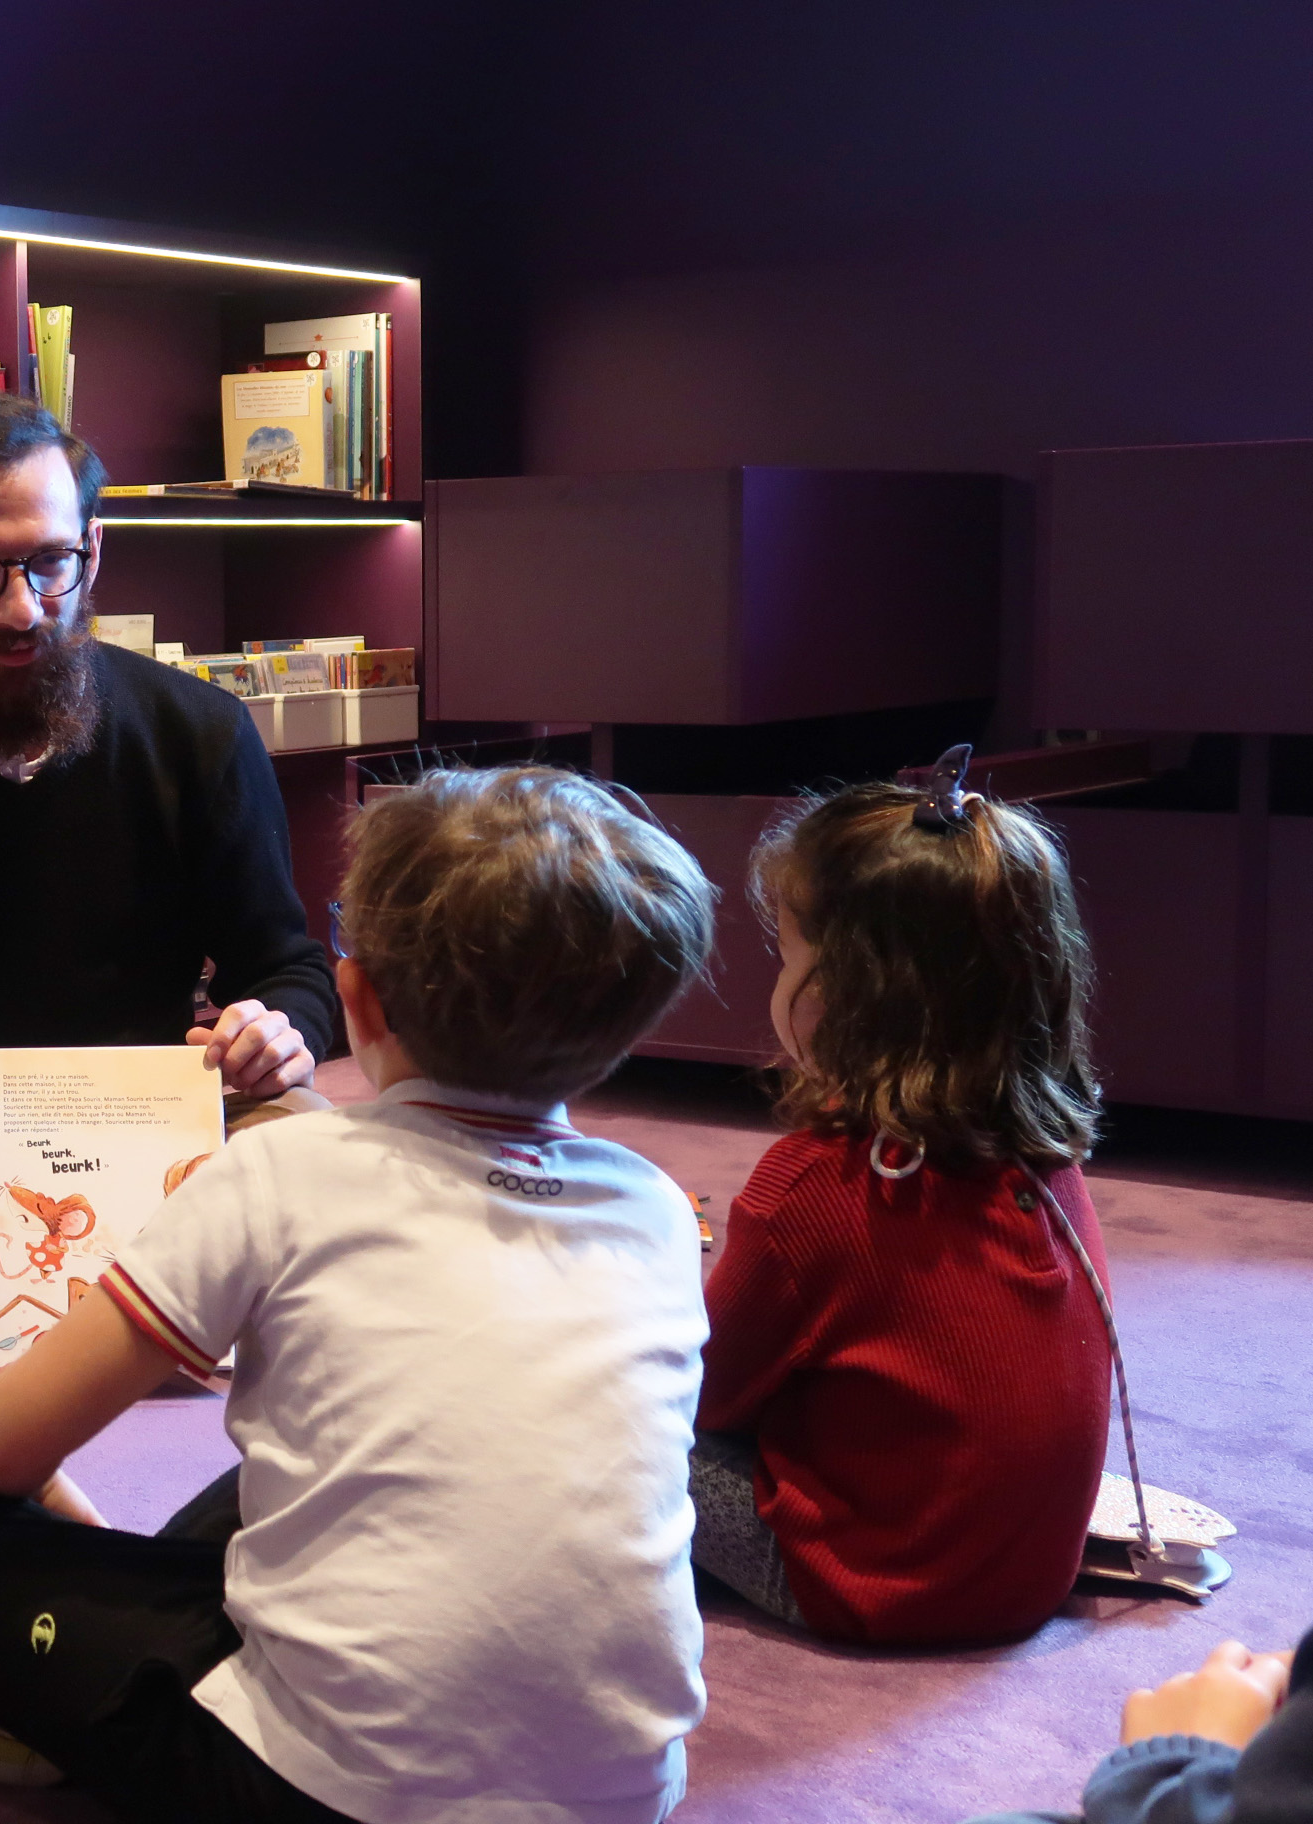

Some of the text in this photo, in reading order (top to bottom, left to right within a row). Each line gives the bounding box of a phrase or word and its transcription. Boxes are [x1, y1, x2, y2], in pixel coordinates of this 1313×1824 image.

[26, 1139, 51, 1148] Beurk
[42, 1148, 76, 1159] beurk,
[51, 1159, 94, 1174] beurk
[487, 1170, 563, 1196] GOCCO
